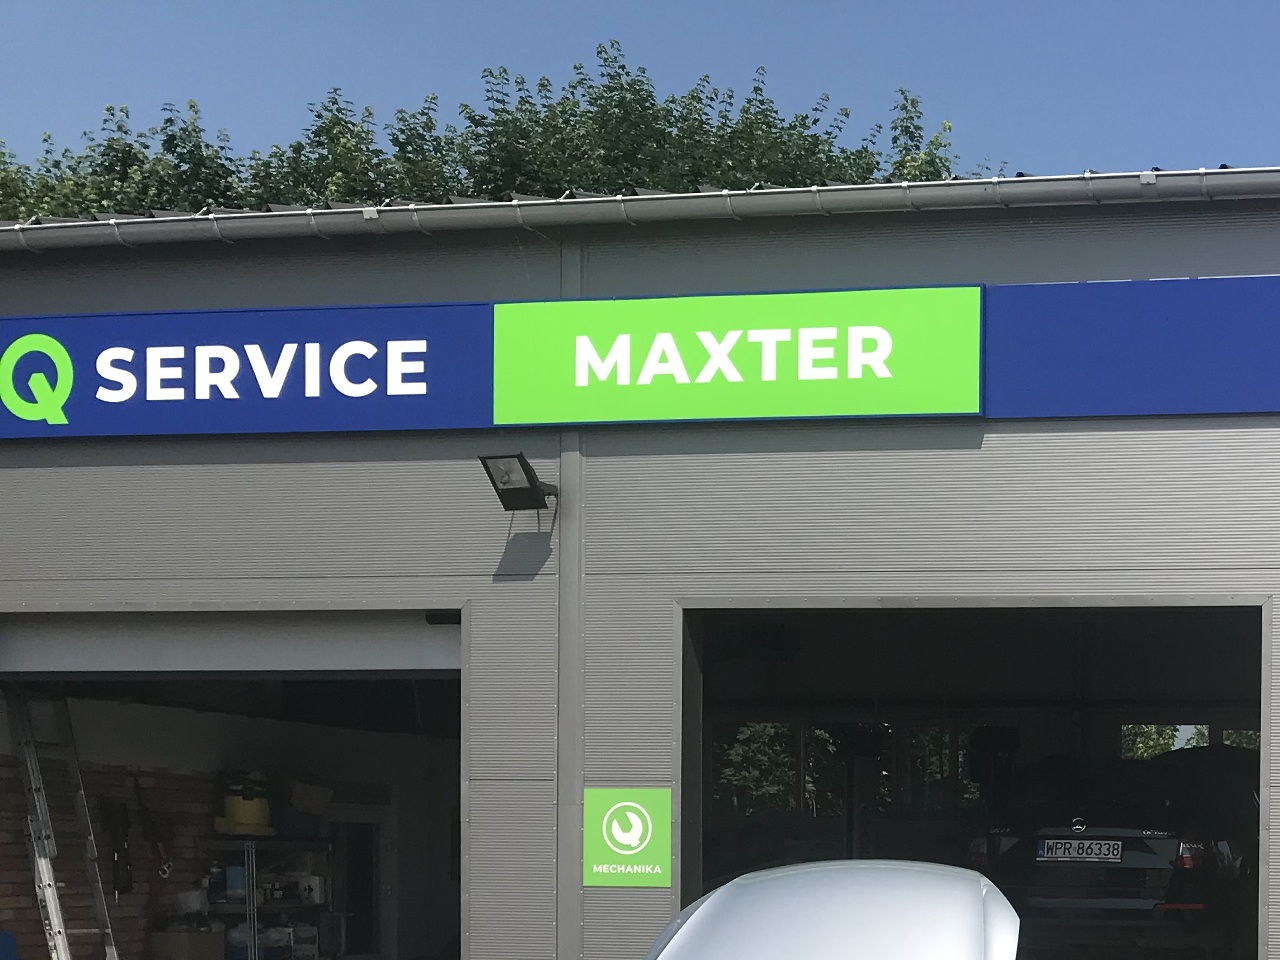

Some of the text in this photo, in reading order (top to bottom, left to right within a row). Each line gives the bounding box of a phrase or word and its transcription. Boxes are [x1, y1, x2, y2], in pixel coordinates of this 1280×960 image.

[574, 325, 894, 387] MAXTER
[0, 333, 428, 425] Q SERVICE
[1046, 841, 1073, 856] WPR
[1076, 841, 1120, 857] 86338
[592, 864, 662, 874] MECHANIKA
